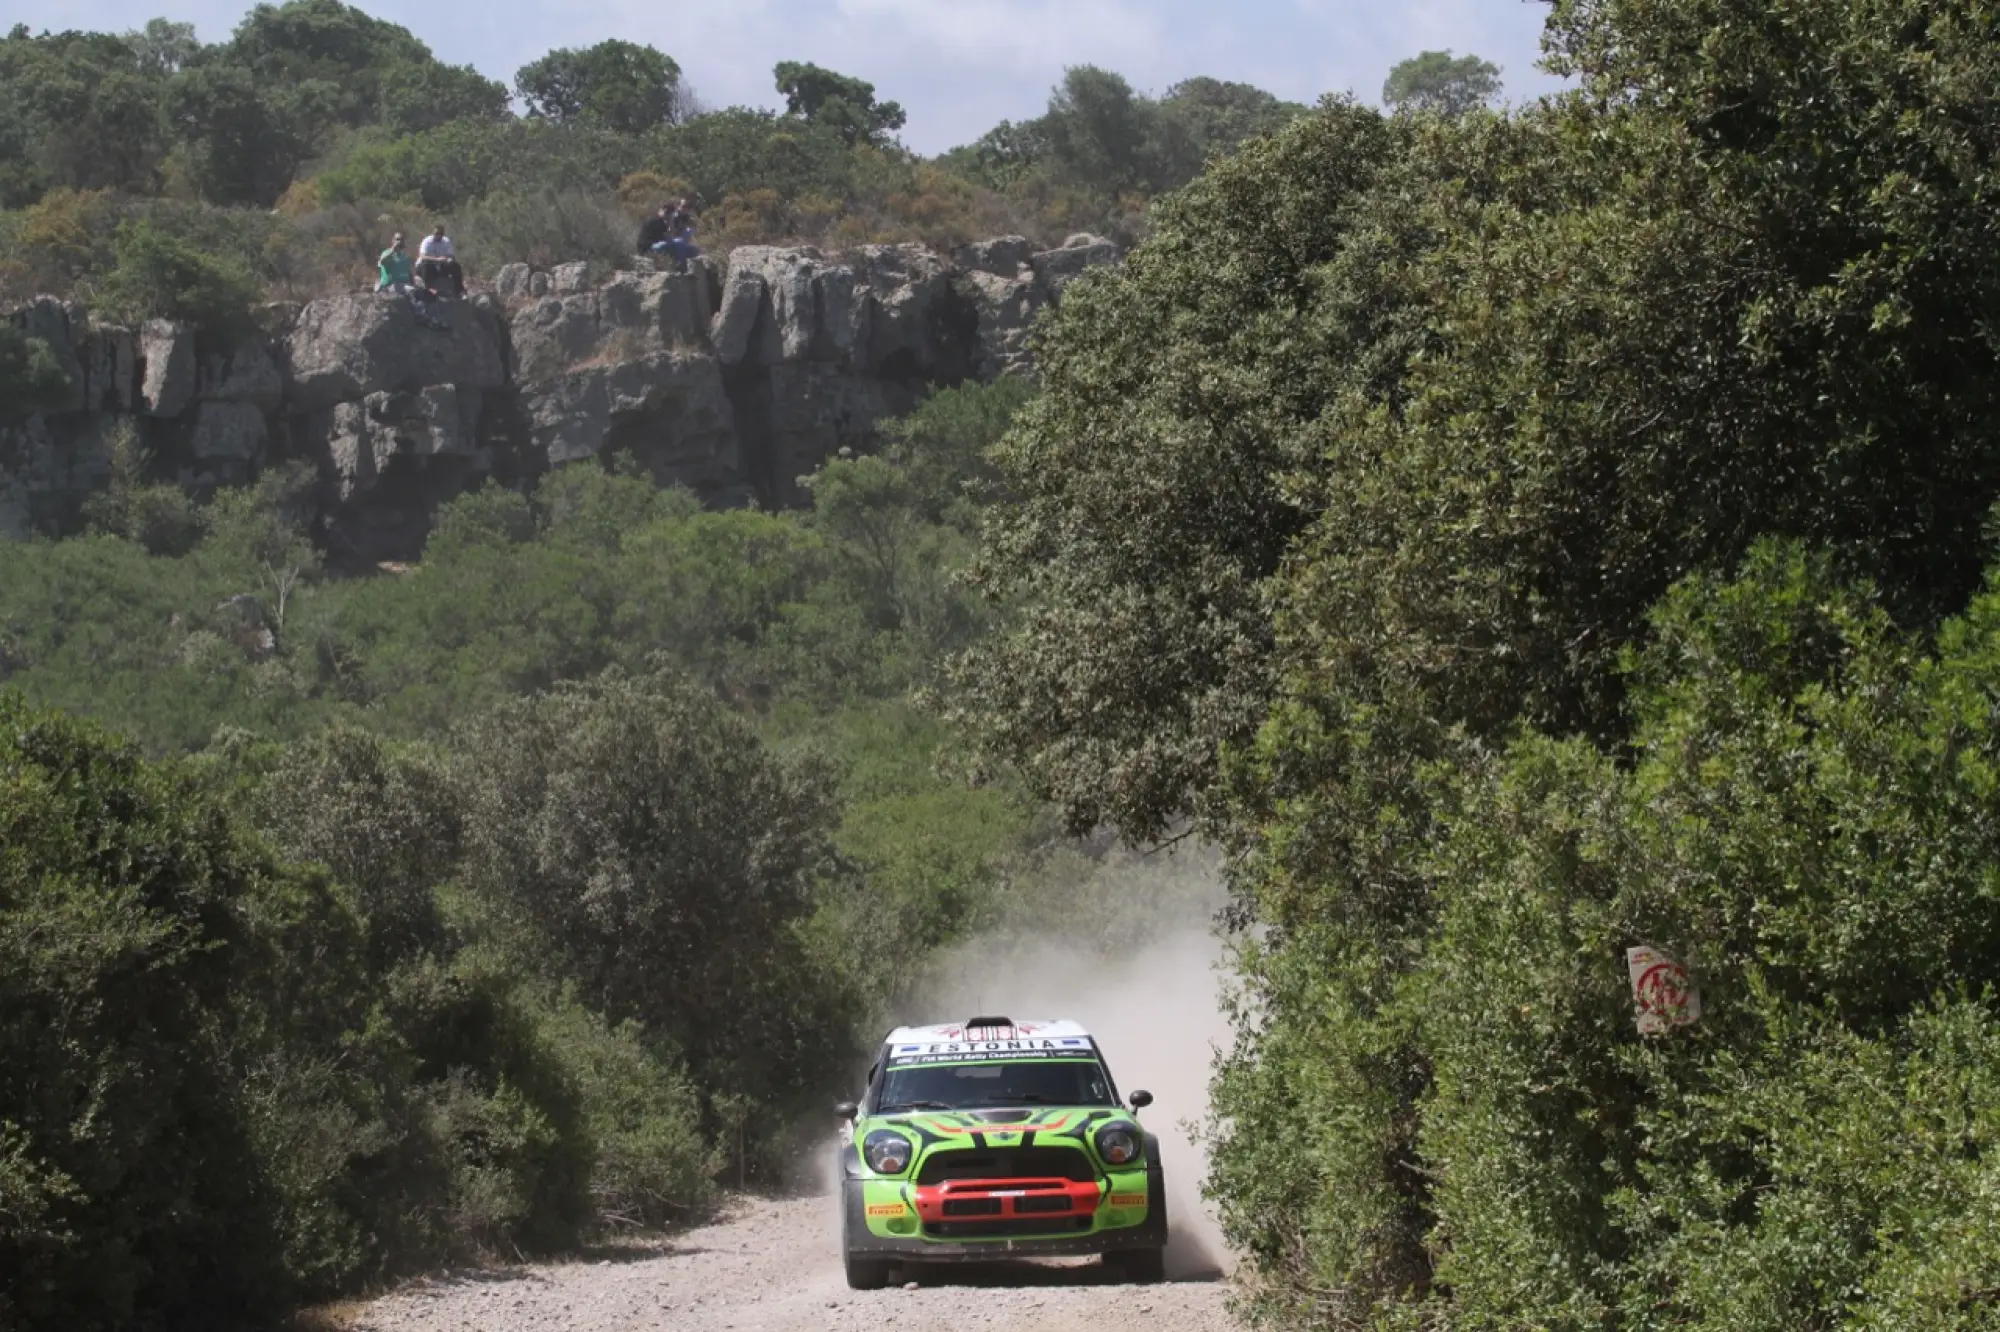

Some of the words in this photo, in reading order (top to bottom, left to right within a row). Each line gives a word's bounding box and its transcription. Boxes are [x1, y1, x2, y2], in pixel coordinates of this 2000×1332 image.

[928, 1040, 1056, 1053] ESTONIA
[964, 1053, 986, 1061] Rally
[988, 1050, 1048, 1060] Championship
[868, 1204, 904, 1215] PIRELLI
